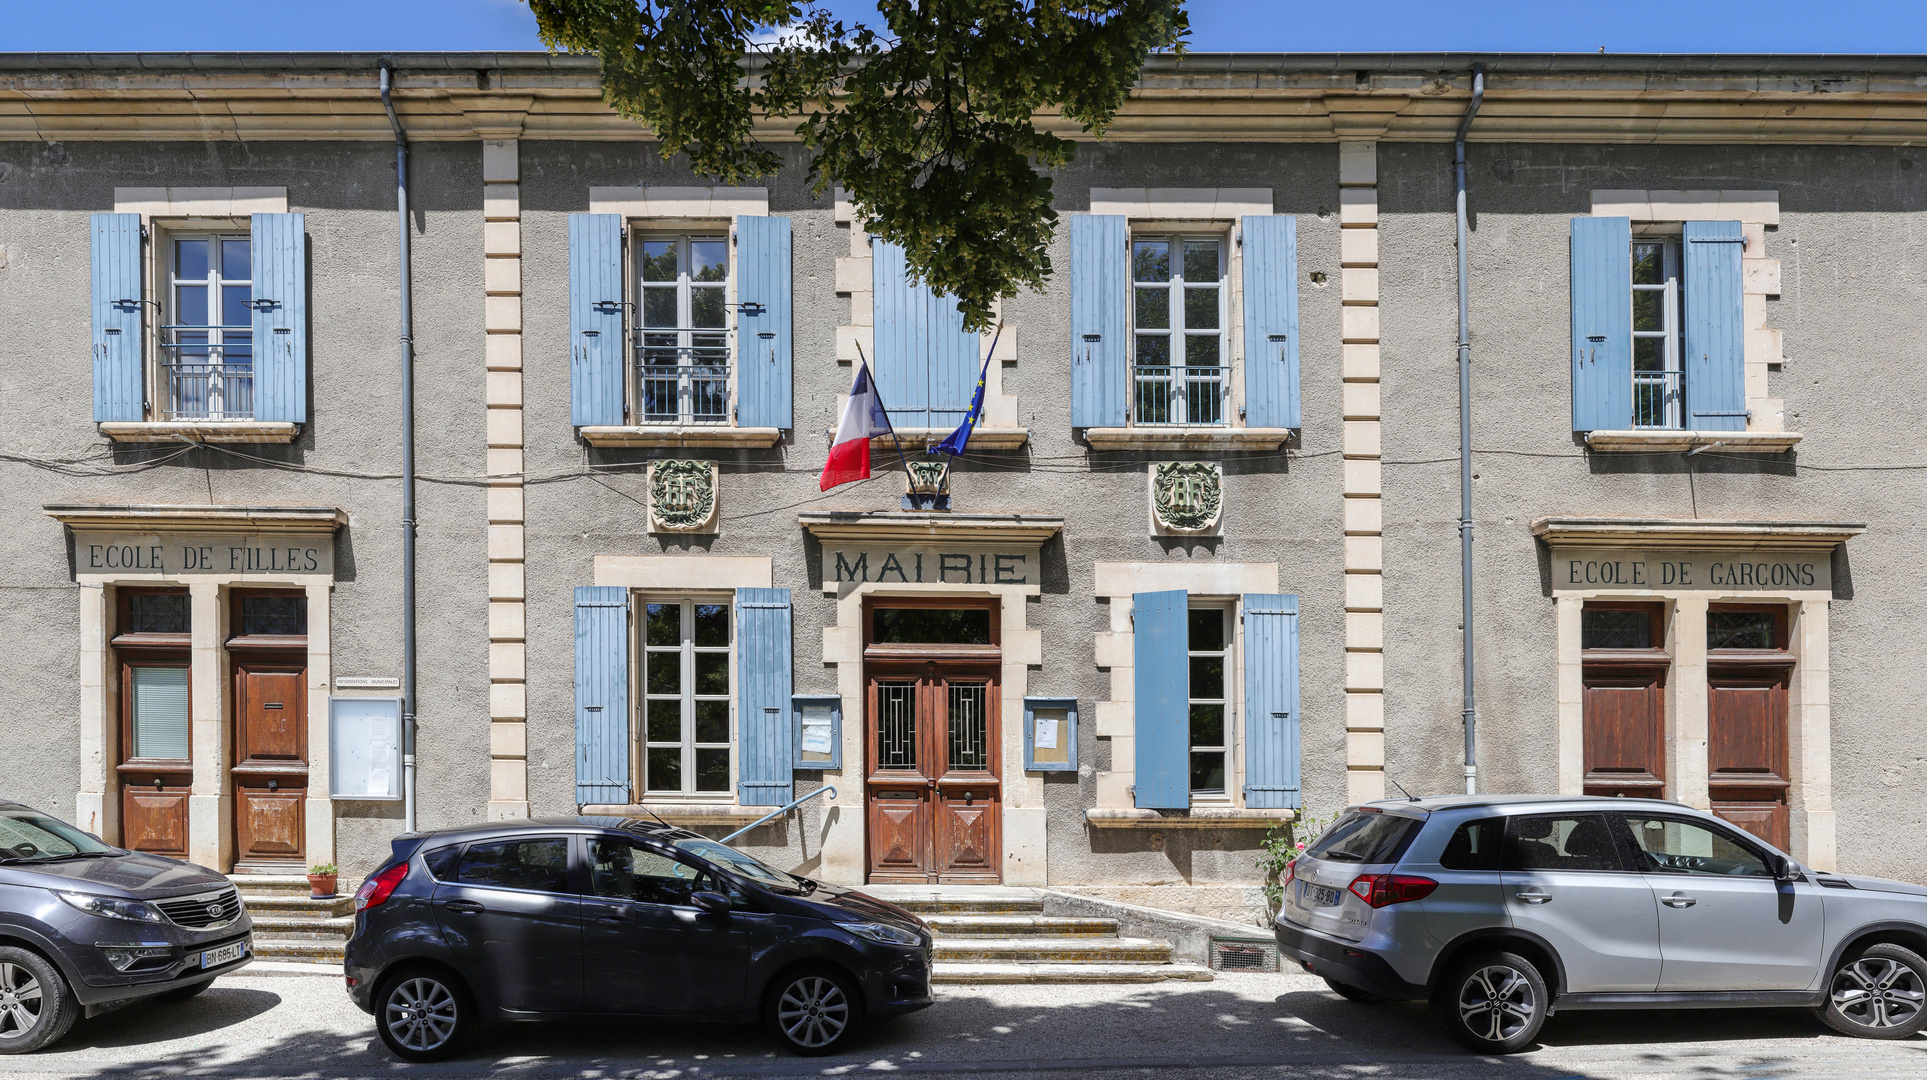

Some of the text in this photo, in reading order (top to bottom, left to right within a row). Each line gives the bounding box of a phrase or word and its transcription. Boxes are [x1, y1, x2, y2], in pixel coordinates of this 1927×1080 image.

[667, 477, 695, 505] RF
[1174, 478, 1202, 505] RF
[89, 545, 318, 571] ECOLE DE FILLES
[834, 551, 1027, 584] MAIRIE
[1568, 560, 1815, 588] ECOLE DE GARÇONS
[206, 945, 240, 965] BN-685-LT
